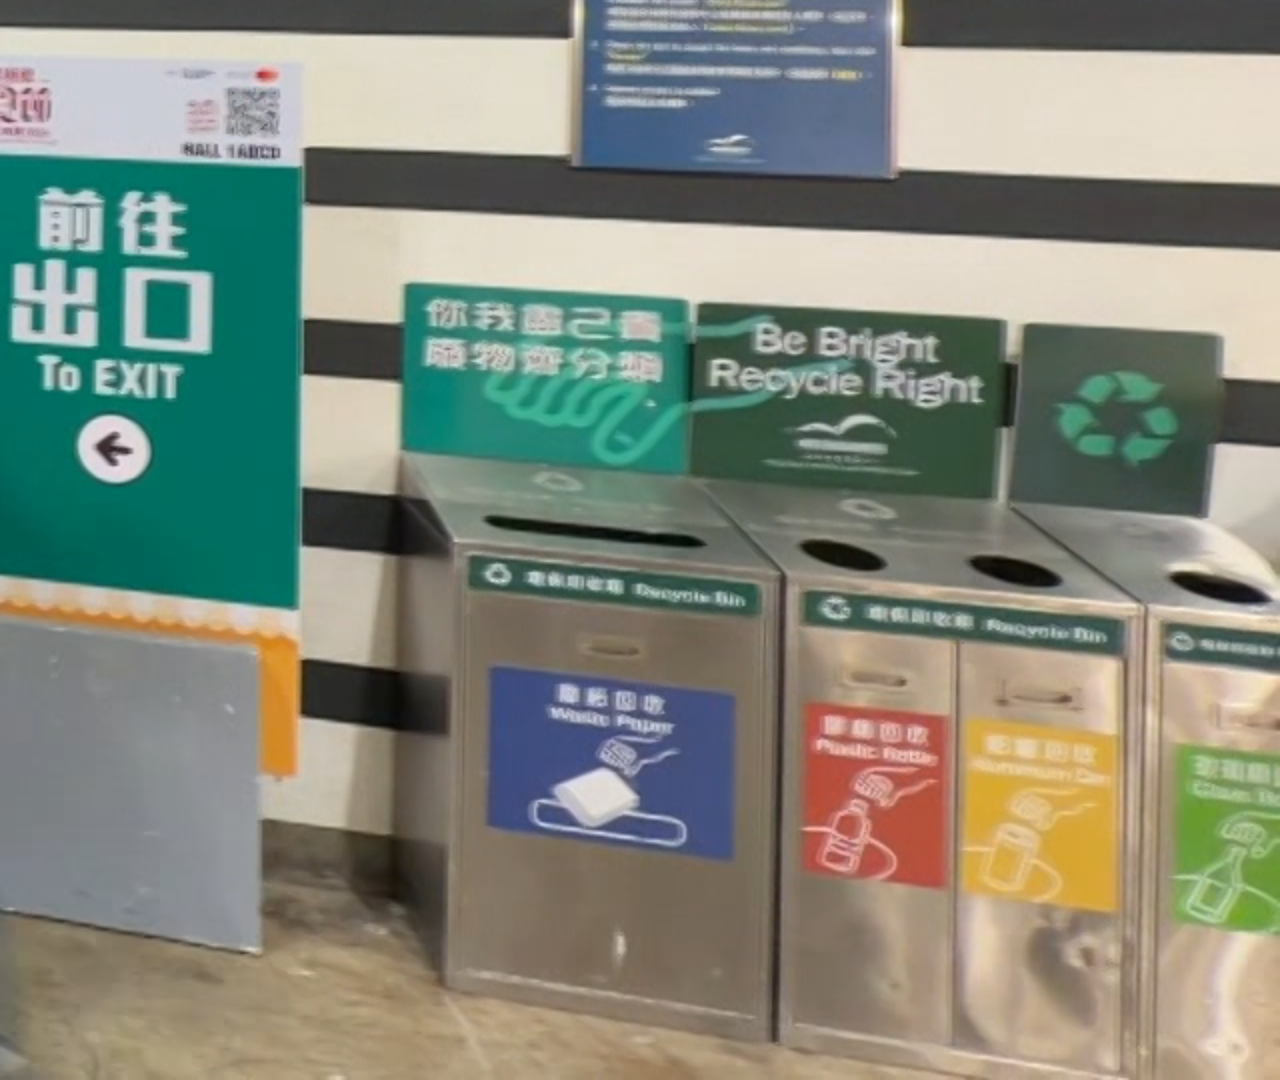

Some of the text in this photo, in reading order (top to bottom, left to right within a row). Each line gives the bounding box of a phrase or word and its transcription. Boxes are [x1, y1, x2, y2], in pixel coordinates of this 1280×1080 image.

[37, 187, 188, 258] 前往
[11, 259, 213, 354] 出口
[754, 323, 939, 363] Be Bright
[37, 354, 184, 400] To EXIT
[709, 358, 985, 408] Recycle Right
[633, 582, 712, 603] Recycle
[715, 591, 746, 607] Bin
[982, 618, 1069, 639] Recycle
[1073, 627, 1107, 644] Bin
[547, 705, 675, 736] Waste Paper
[813, 738, 879, 759] Plastic
